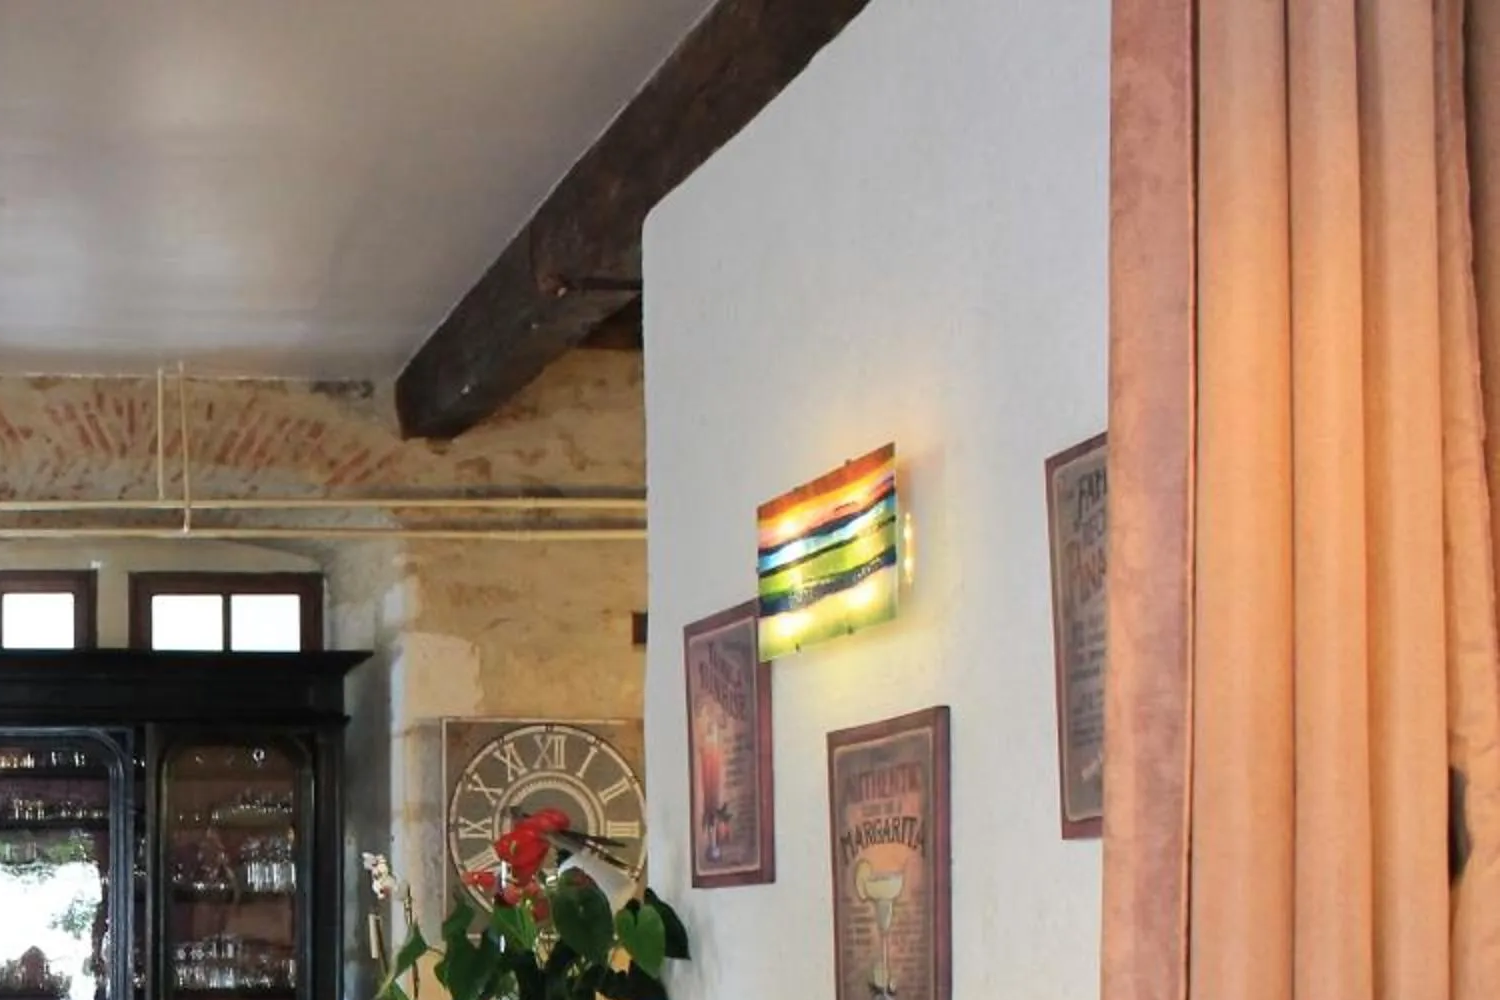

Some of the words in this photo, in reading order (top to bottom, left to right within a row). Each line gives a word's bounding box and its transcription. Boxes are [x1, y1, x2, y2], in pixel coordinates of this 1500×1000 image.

[534, 735, 567, 769] XII
[467, 773, 502, 805] X
[599, 777, 631, 805] II
[458, 816, 492, 840] IX
[606, 820, 640, 839] III
[839, 815, 927, 864] MARGARITA
